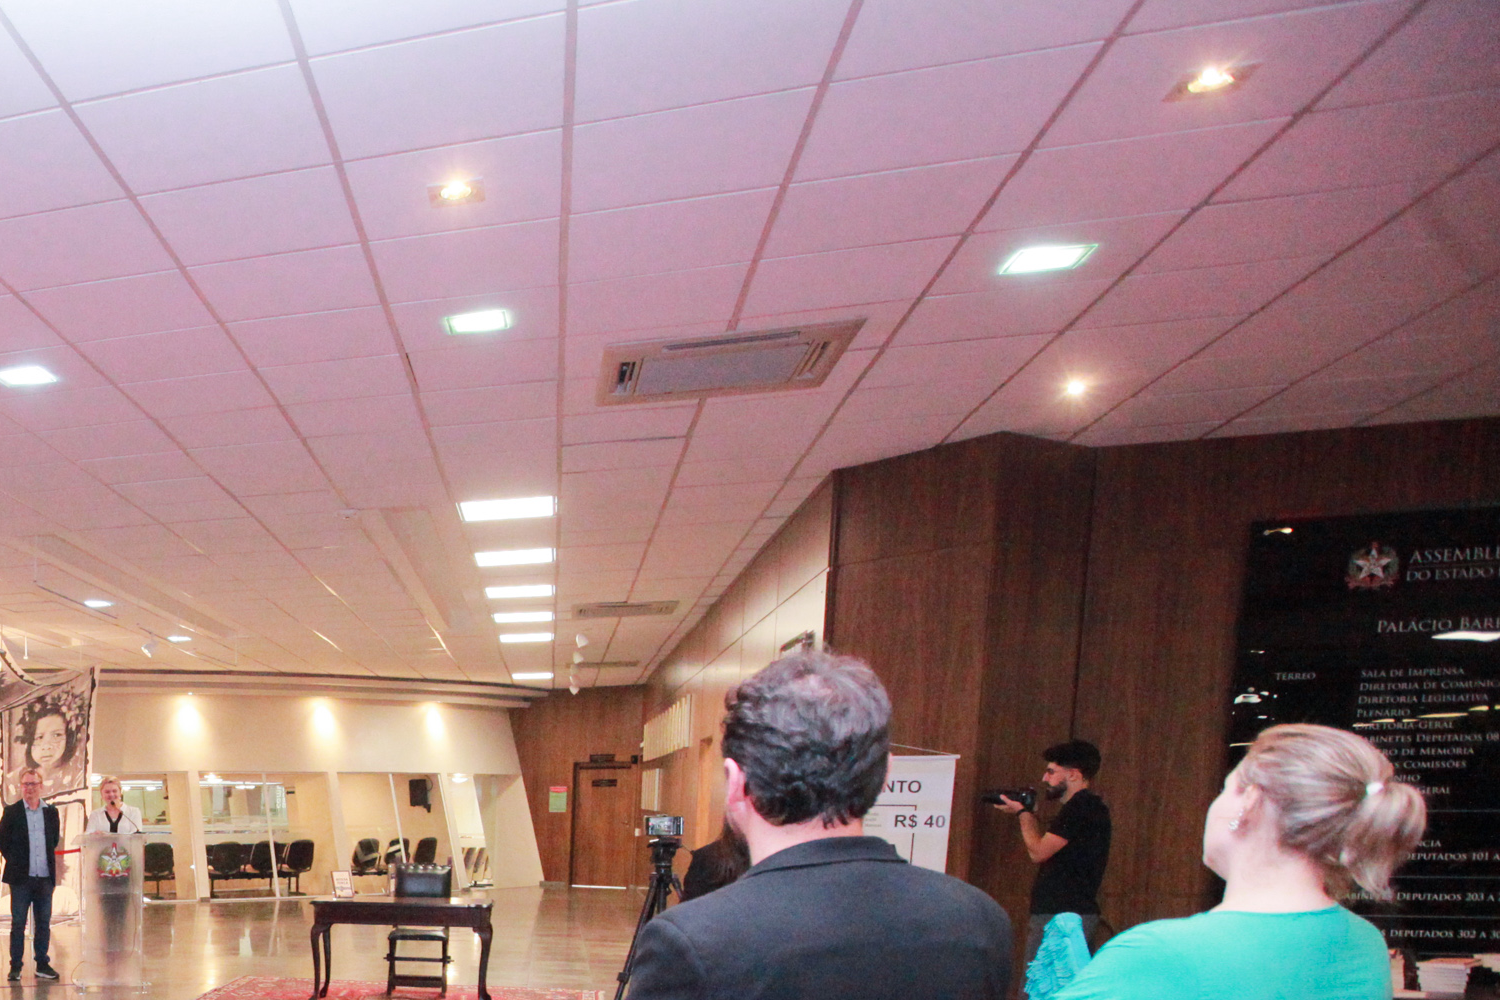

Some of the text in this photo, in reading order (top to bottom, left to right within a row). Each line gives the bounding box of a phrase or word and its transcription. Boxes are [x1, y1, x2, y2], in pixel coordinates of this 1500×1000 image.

[1406, 569, 1431, 581] DO
[1435, 567, 1494, 580] ESTADO
[1361, 666, 1465, 678] SALA DE IMPRENSA
[1360, 682, 1419, 691] DIRETORIA
[1423, 681, 1438, 690] DE
[1358, 693, 1489, 704] DIRETORIA LEGISLATIVA
[1416, 732, 1483, 743] DEPUTADOS
[1401, 748, 1416, 756] DE
[883, 780, 922, 793] NTO
[894, 814, 917, 829] R$
[924, 814, 946, 828] 40
[1472, 852, 1489, 861] 101
[1396, 892, 1462, 901] DEPUTADOS
[1390, 929, 1454, 939] DEPUTADOS
